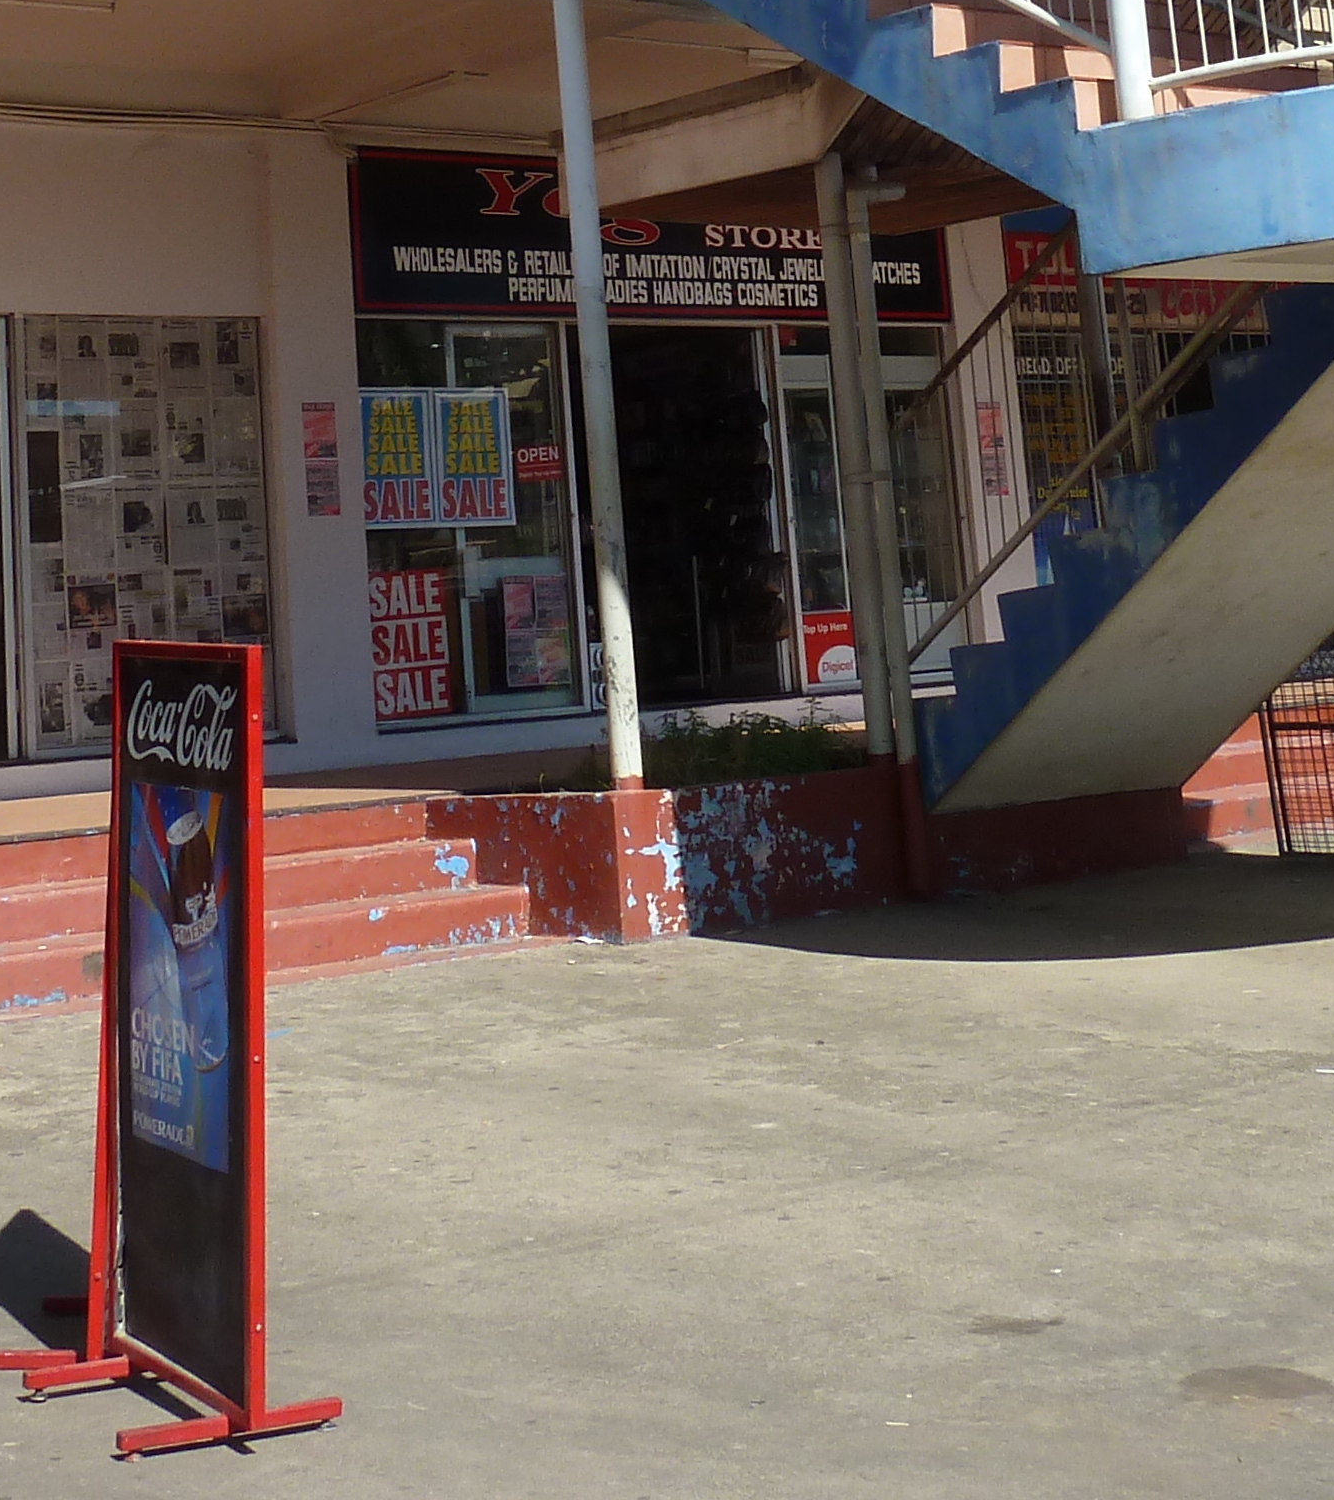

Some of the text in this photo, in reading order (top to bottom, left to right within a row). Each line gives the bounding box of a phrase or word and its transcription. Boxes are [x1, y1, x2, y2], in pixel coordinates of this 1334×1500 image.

[393, 246, 502, 274] WHOLESALERS
[508, 251, 518, 274] &
[524, 251, 574, 276] RETAIL
[603, 253, 620, 276] OF
[872, 261, 921, 285] ATCHES
[508, 277, 818, 307] PERFUM ADIES HANDBAGS COSMETICS
[372, 398, 413, 416] SALE
[451, 401, 490, 416] SALE
[371, 416, 416, 434] SALE
[449, 416, 492, 434] SALE
[369, 434, 418, 452] SALE
[448, 434, 496, 451] SALE
[517, 446, 559, 463] OPEN
[367, 453, 423, 475] SALE
[446, 453, 500, 474] SALE
[363, 480, 432, 520] SALE
[442, 479, 507, 519] SALE
[369, 572, 442, 618] SALE
[372, 620, 445, 666] SALE
[376, 668, 449, 716] SALE
[127, 679, 238, 771] Coca-Cola
[132, 1007, 195, 1057] CHOSEN
[132, 1039, 184, 1087] BY FIFA
